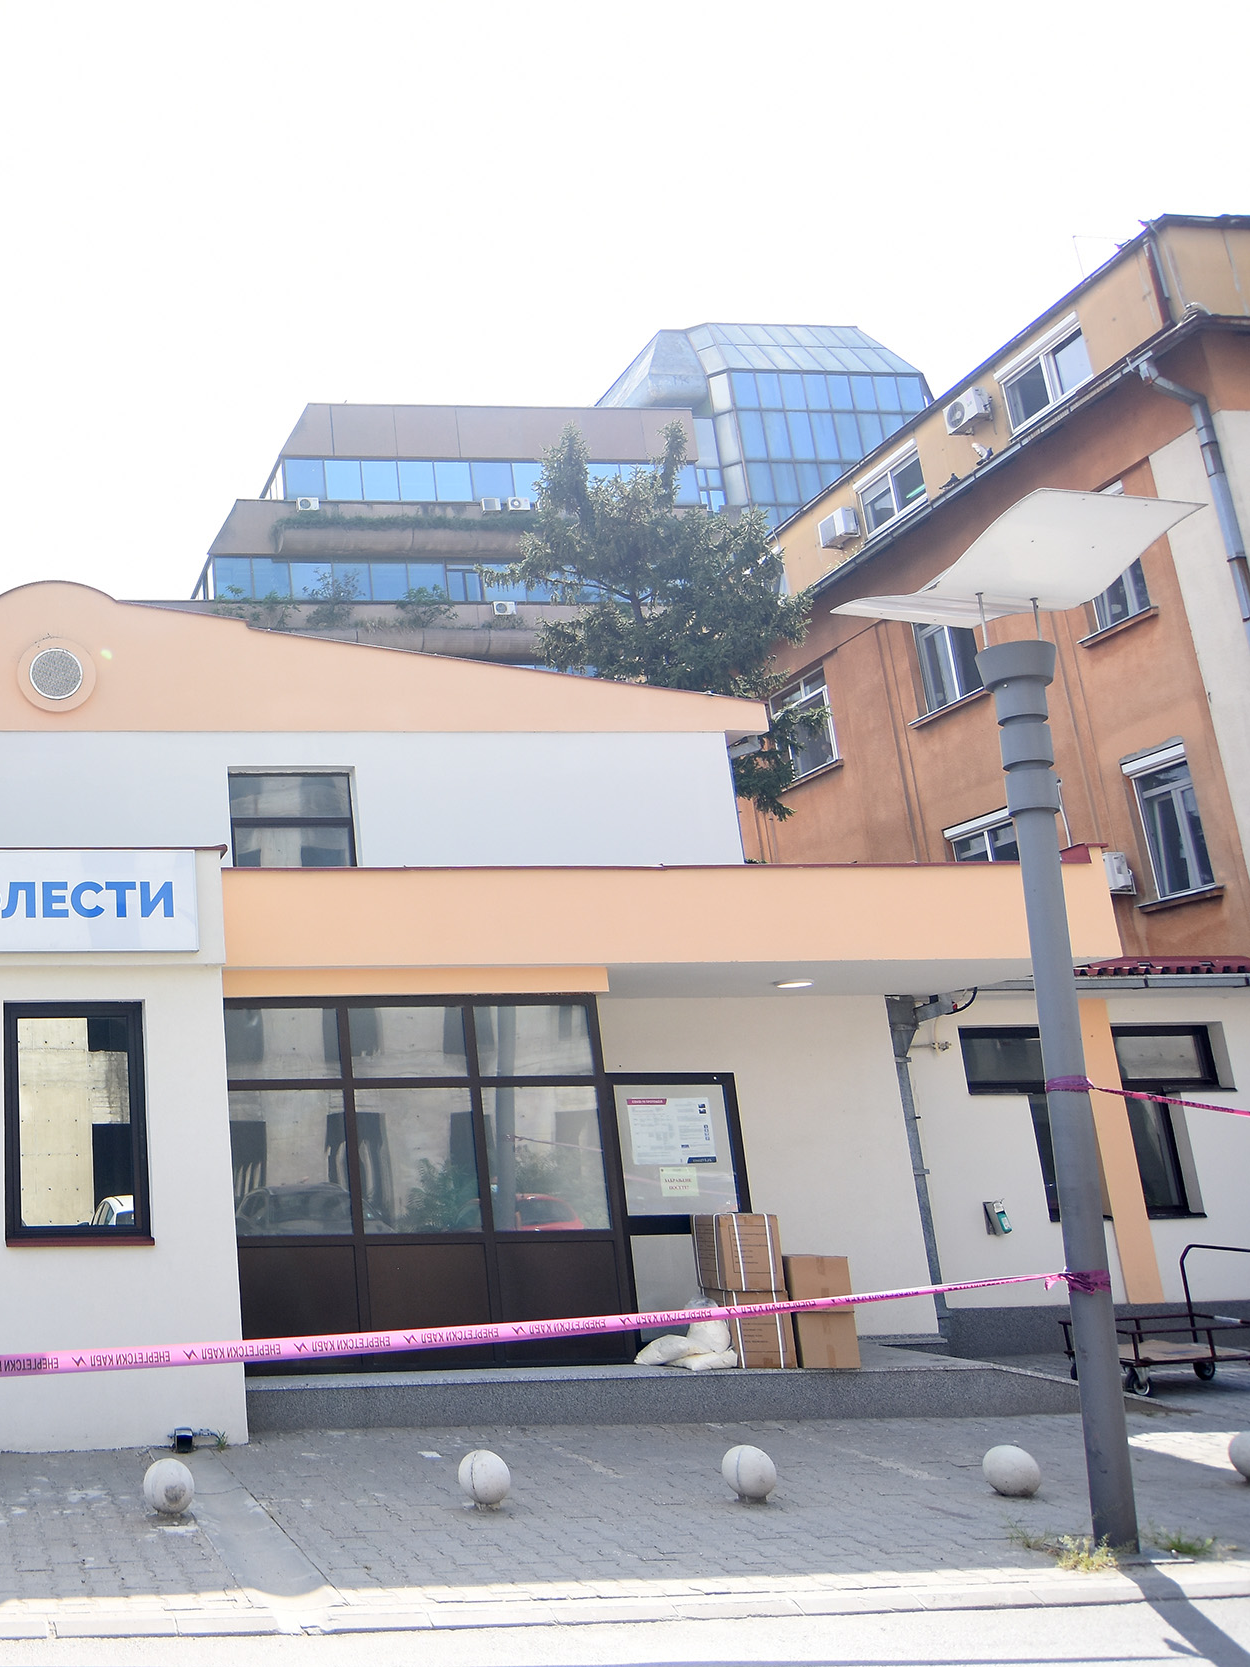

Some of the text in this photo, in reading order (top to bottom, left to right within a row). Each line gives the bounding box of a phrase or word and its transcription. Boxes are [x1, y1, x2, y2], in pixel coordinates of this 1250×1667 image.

[445, 1327, 499, 1341] ЕНЕРГЕТСКИ
[201, 1343, 282, 1360] ЕНЕРГЕТСКИ КАБЛ
[311, 1336, 391, 1353] ЕНЕРГЕТСКИ КАБЛ
[4, 1357, 59, 1372] ЕНЕРГЕТСКИ
[90, 1350, 171, 1367] ЕНЕРГЕТСКИ КАБЛ
